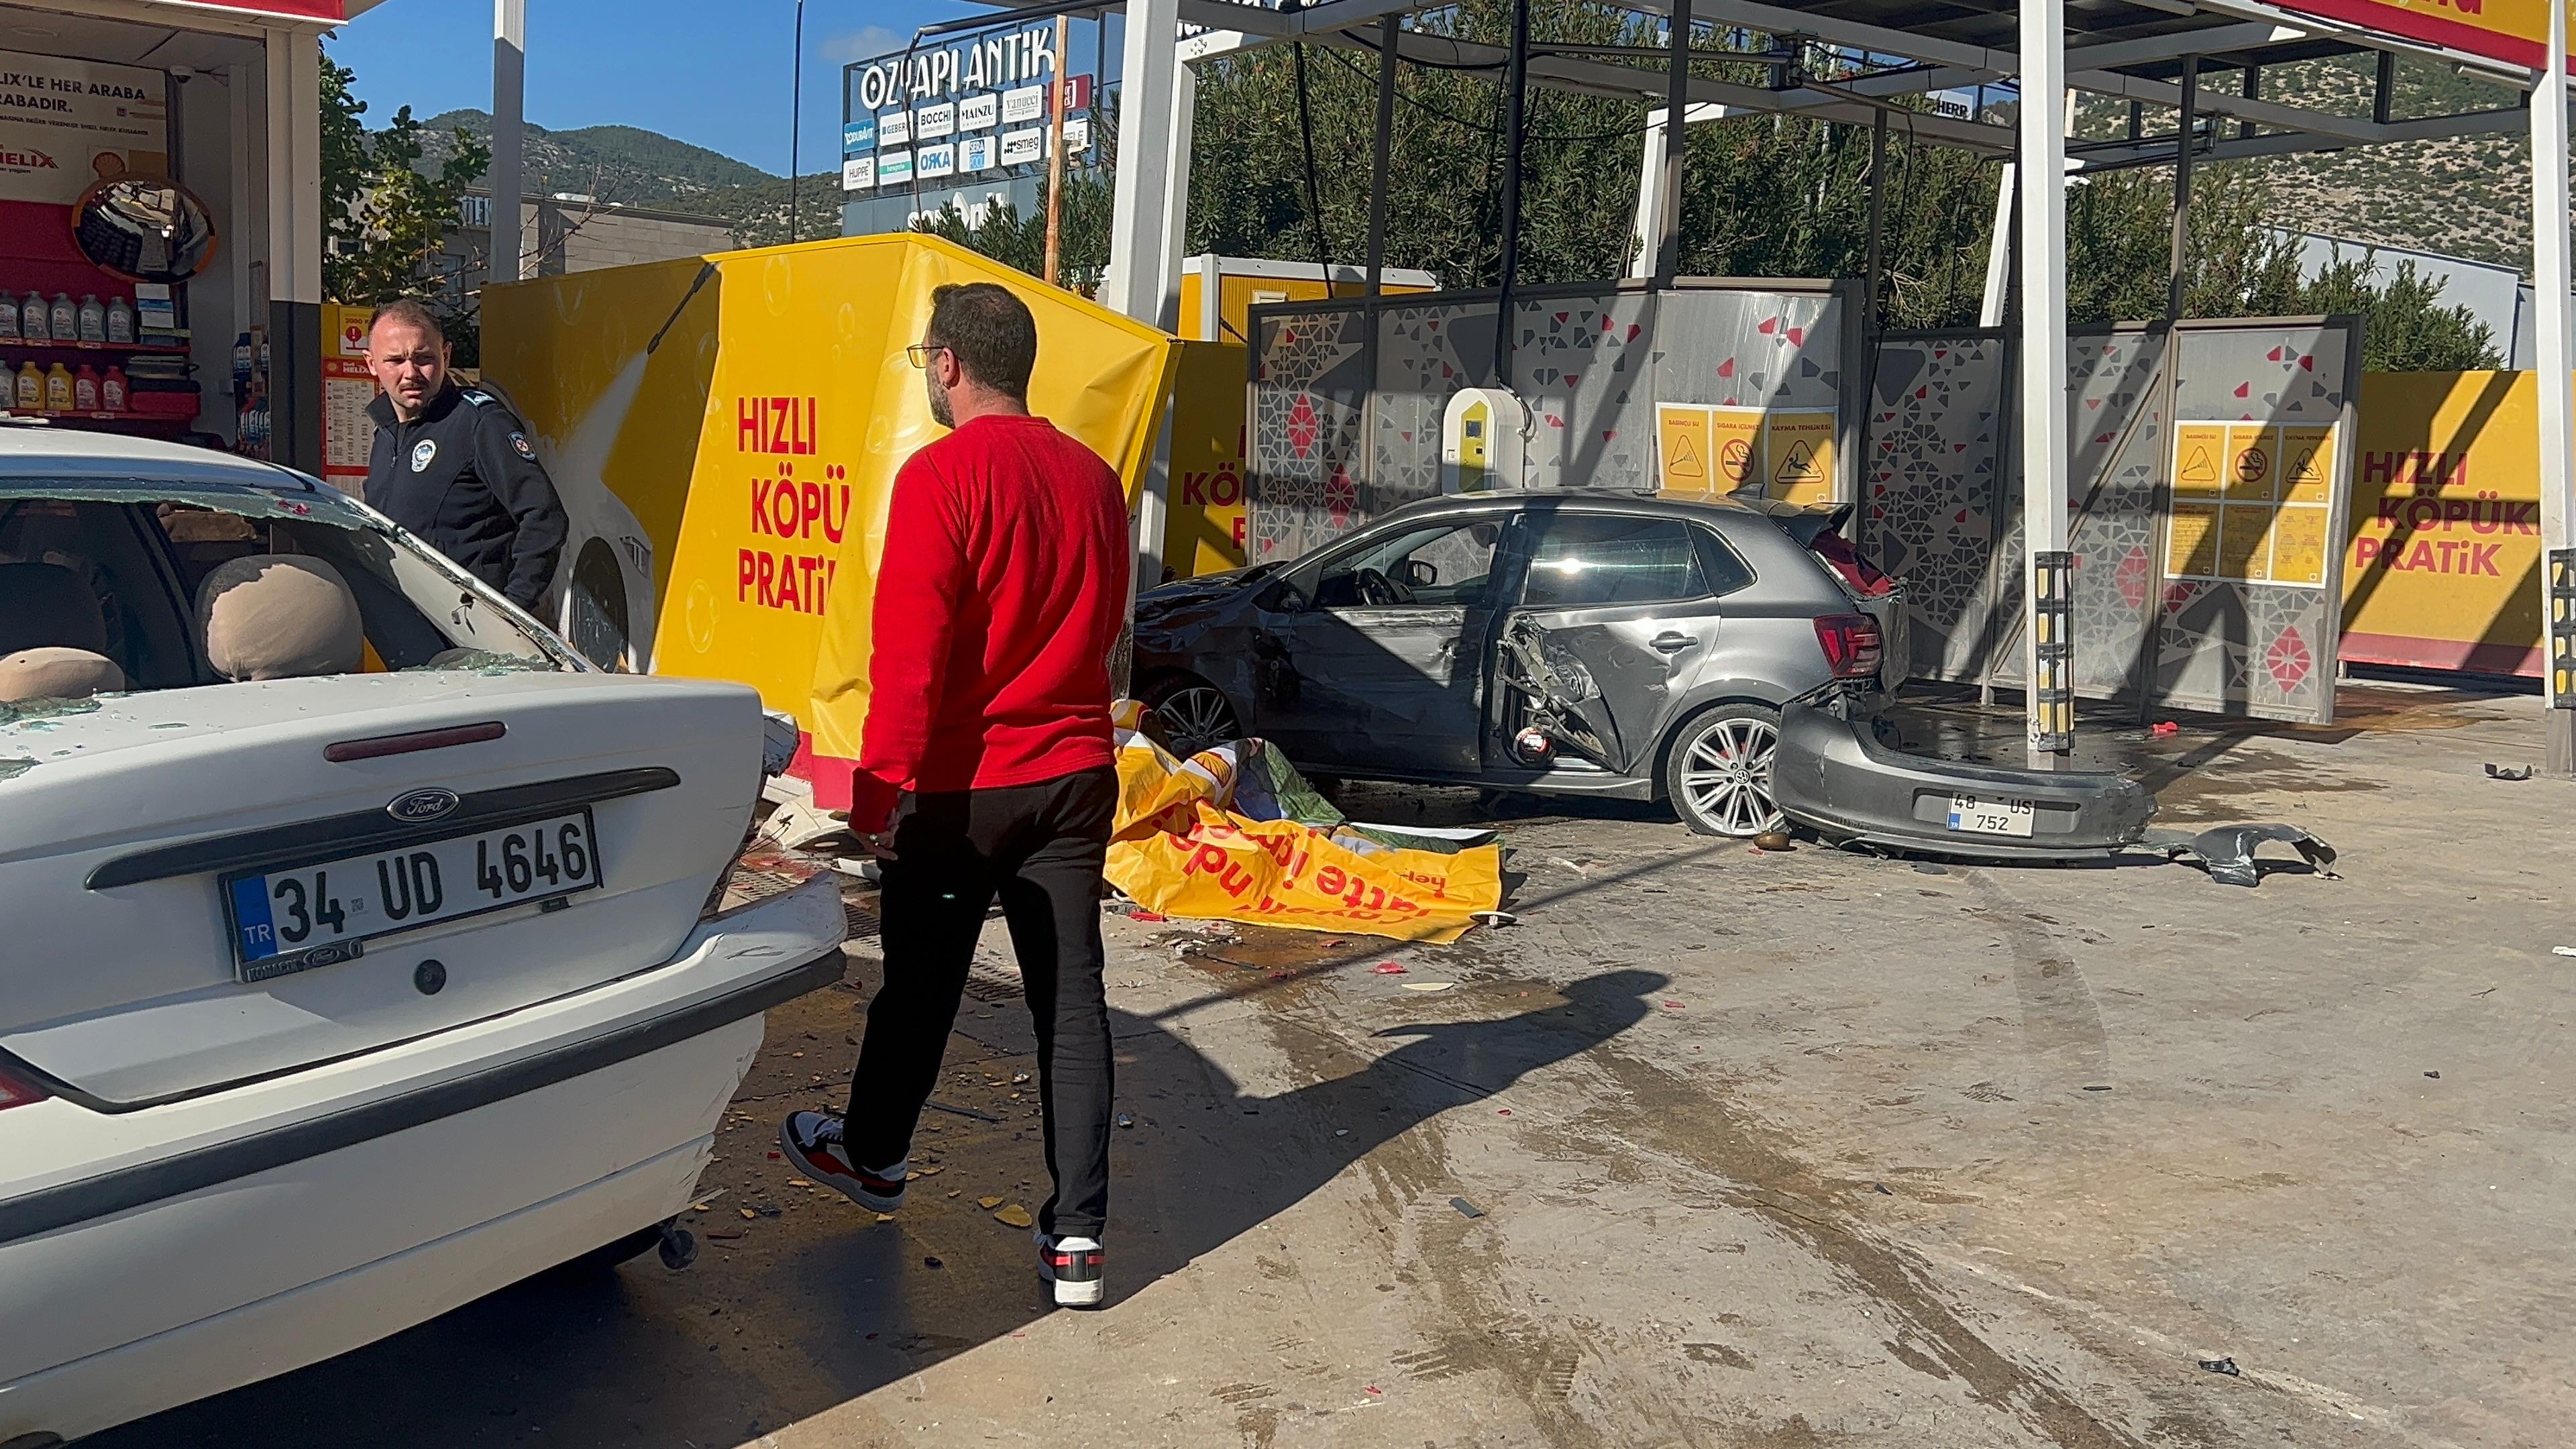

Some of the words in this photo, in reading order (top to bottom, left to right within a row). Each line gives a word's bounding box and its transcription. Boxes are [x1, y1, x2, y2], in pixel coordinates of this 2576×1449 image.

[51, 78, 82, 93] HER
[89, 84, 146, 100] ARABA
[921, 110, 951, 126] BOCCHI
[961, 104, 994, 120] MAINZU
[887, 121, 910, 134] GEBER
[1016, 136, 1038, 150] smeg
[737, 396, 816, 455] HIZLI
[2364, 451, 2468, 486] HIZLI
[751, 462, 852, 543] KÖPÜ
[2377, 489, 2540, 537] KÖPÜK
[405, 794, 444, 815] Ford
[1954, 794, 1976, 810] 48
[2010, 799, 2033, 815] US
[1976, 814, 2008, 831] 752
[274, 871, 345, 943] 34
[376, 850, 443, 921] UD
[476, 822, 586, 899] 4646
[244, 923, 272, 945] TR
